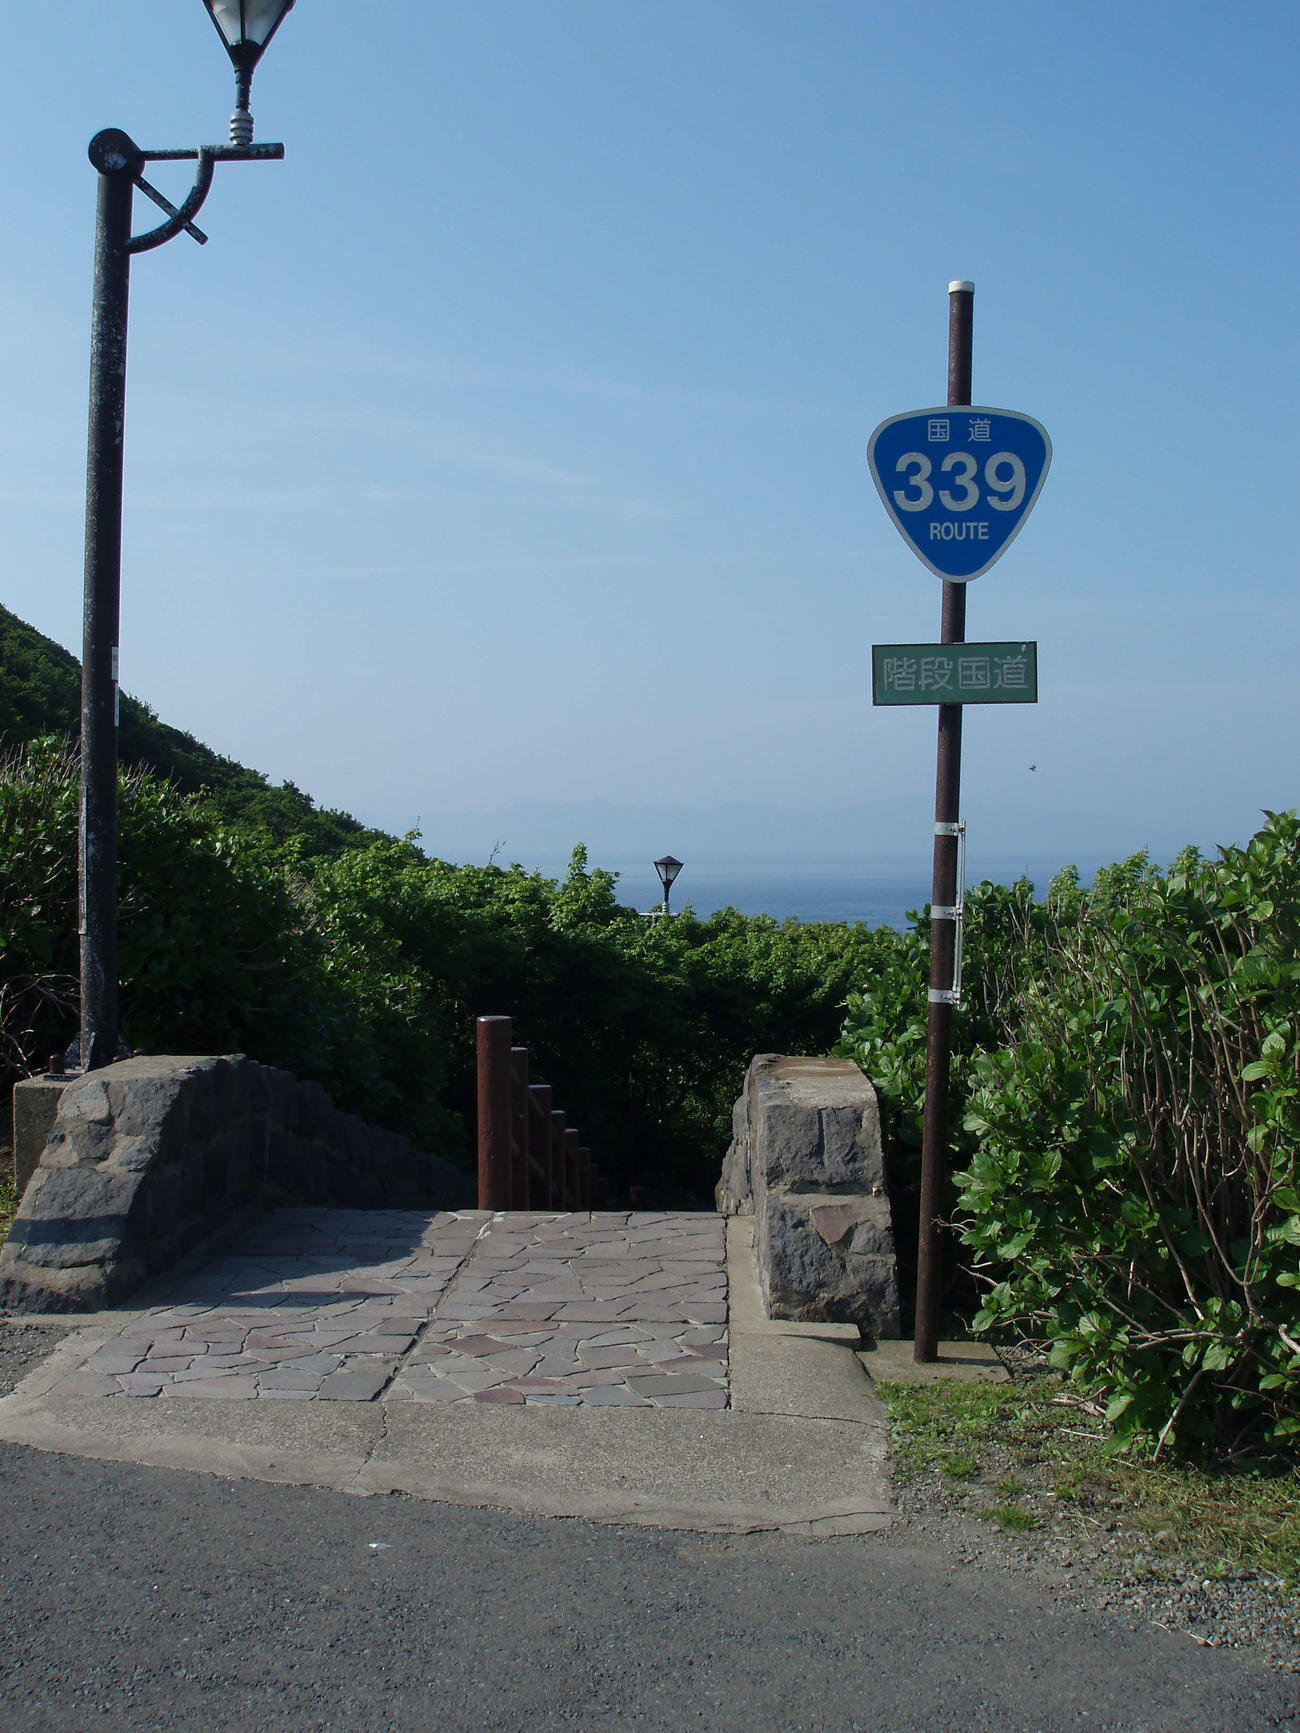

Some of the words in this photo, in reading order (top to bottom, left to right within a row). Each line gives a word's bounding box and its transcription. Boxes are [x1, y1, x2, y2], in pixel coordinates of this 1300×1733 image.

[928, 418, 992, 442] 国道
[893, 451, 1026, 512] 339
[929, 522, 989, 540] ROUTE
[883, 655, 1028, 692] 階段国道
